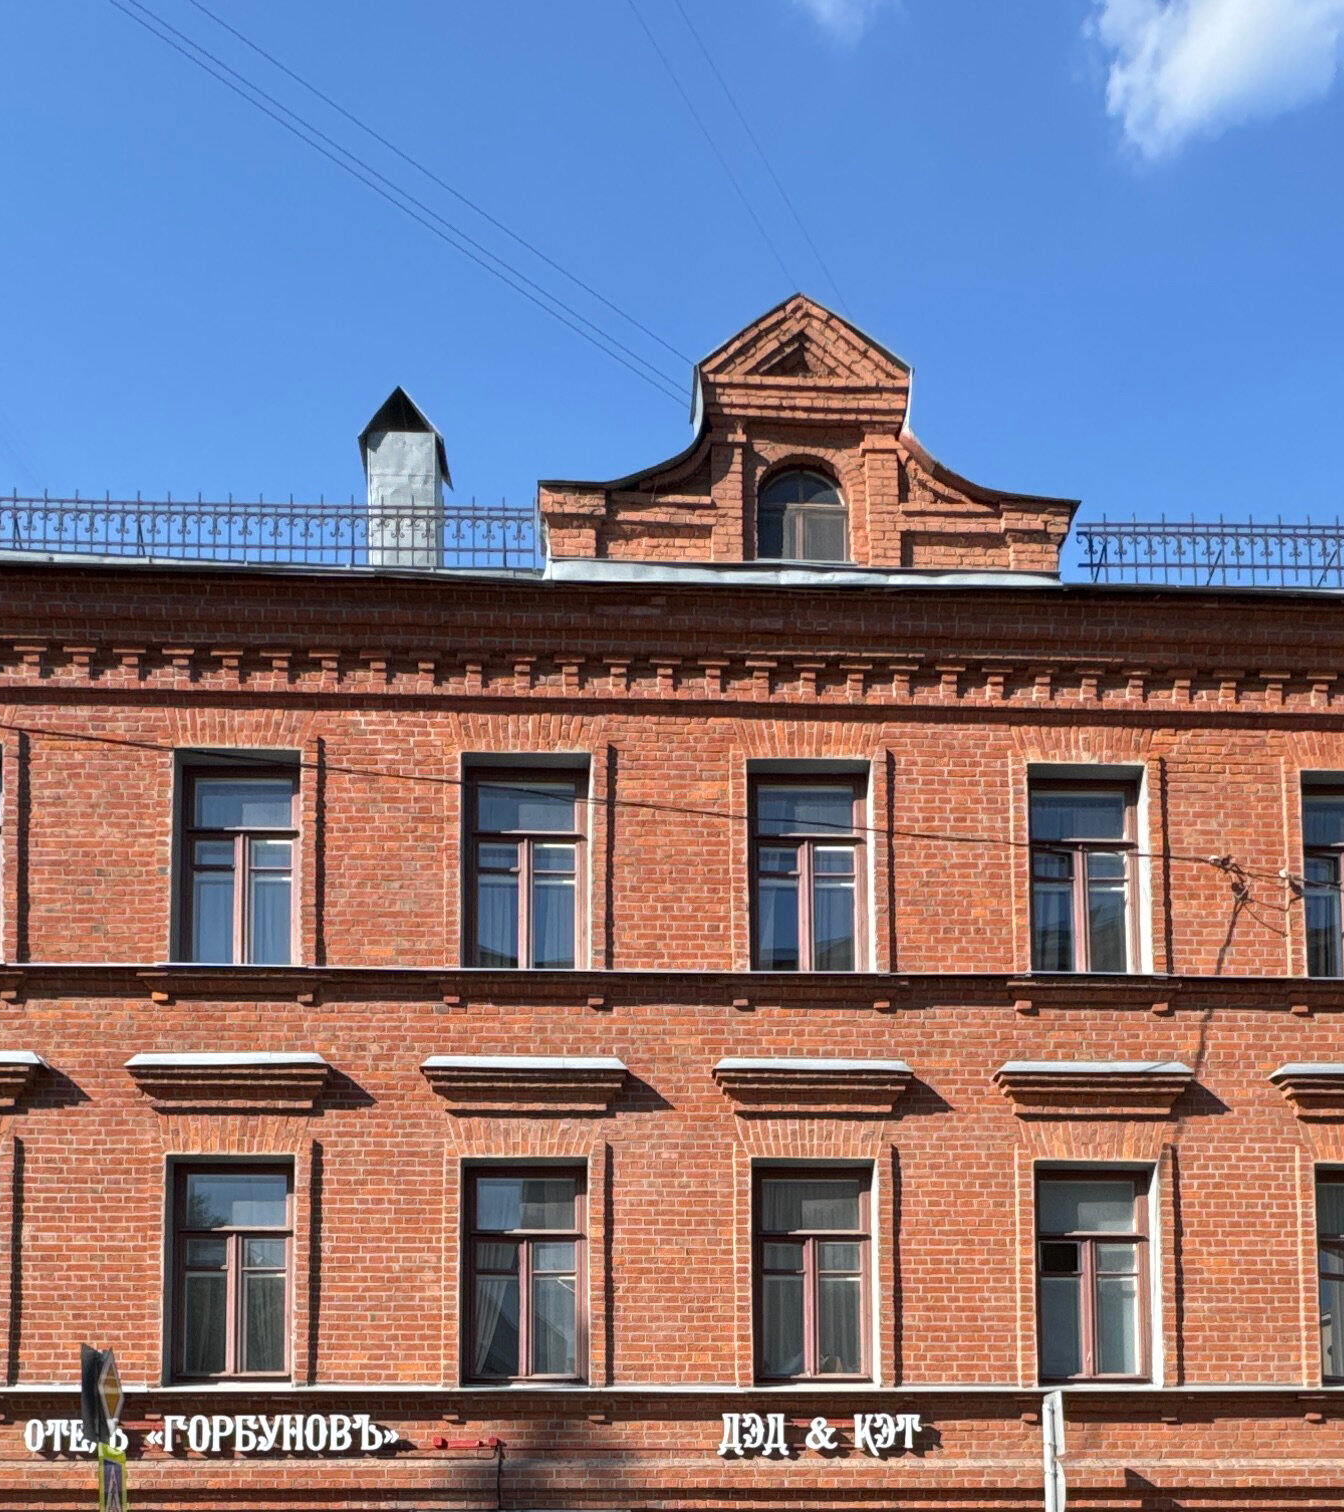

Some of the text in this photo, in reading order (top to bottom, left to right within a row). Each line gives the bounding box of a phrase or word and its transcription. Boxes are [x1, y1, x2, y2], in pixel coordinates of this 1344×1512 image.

[23, 1418, 129, 1454] ОТЕЬ
[716, 1412, 922, 1456] ДЭД & КЭТ
